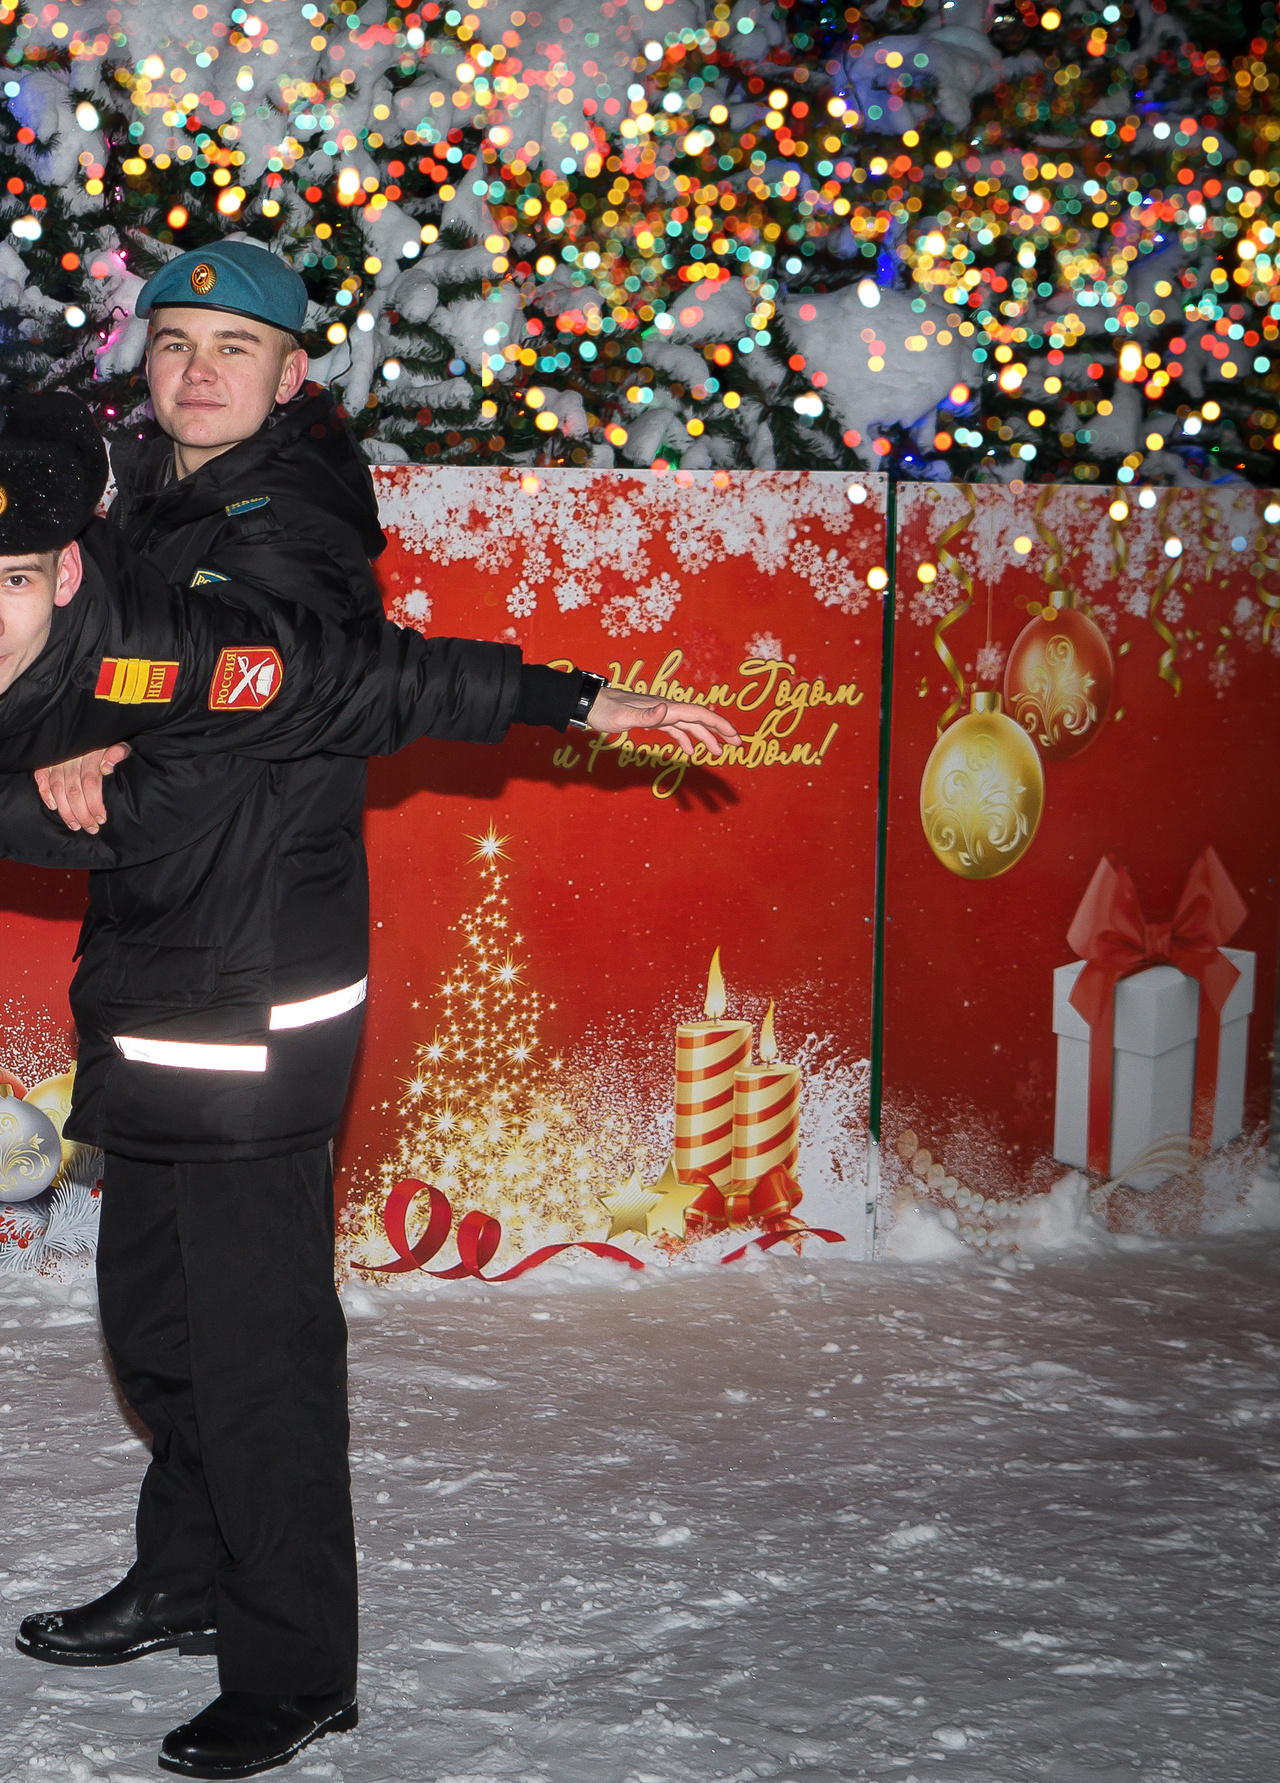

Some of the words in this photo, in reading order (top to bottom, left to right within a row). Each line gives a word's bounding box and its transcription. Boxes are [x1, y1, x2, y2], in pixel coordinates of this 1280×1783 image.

[146, 666, 166, 698] НКШ
[216, 652, 237, 705] РОССИЯ
[736, 658, 865, 738] Годом
[552, 744, 581, 769] и
